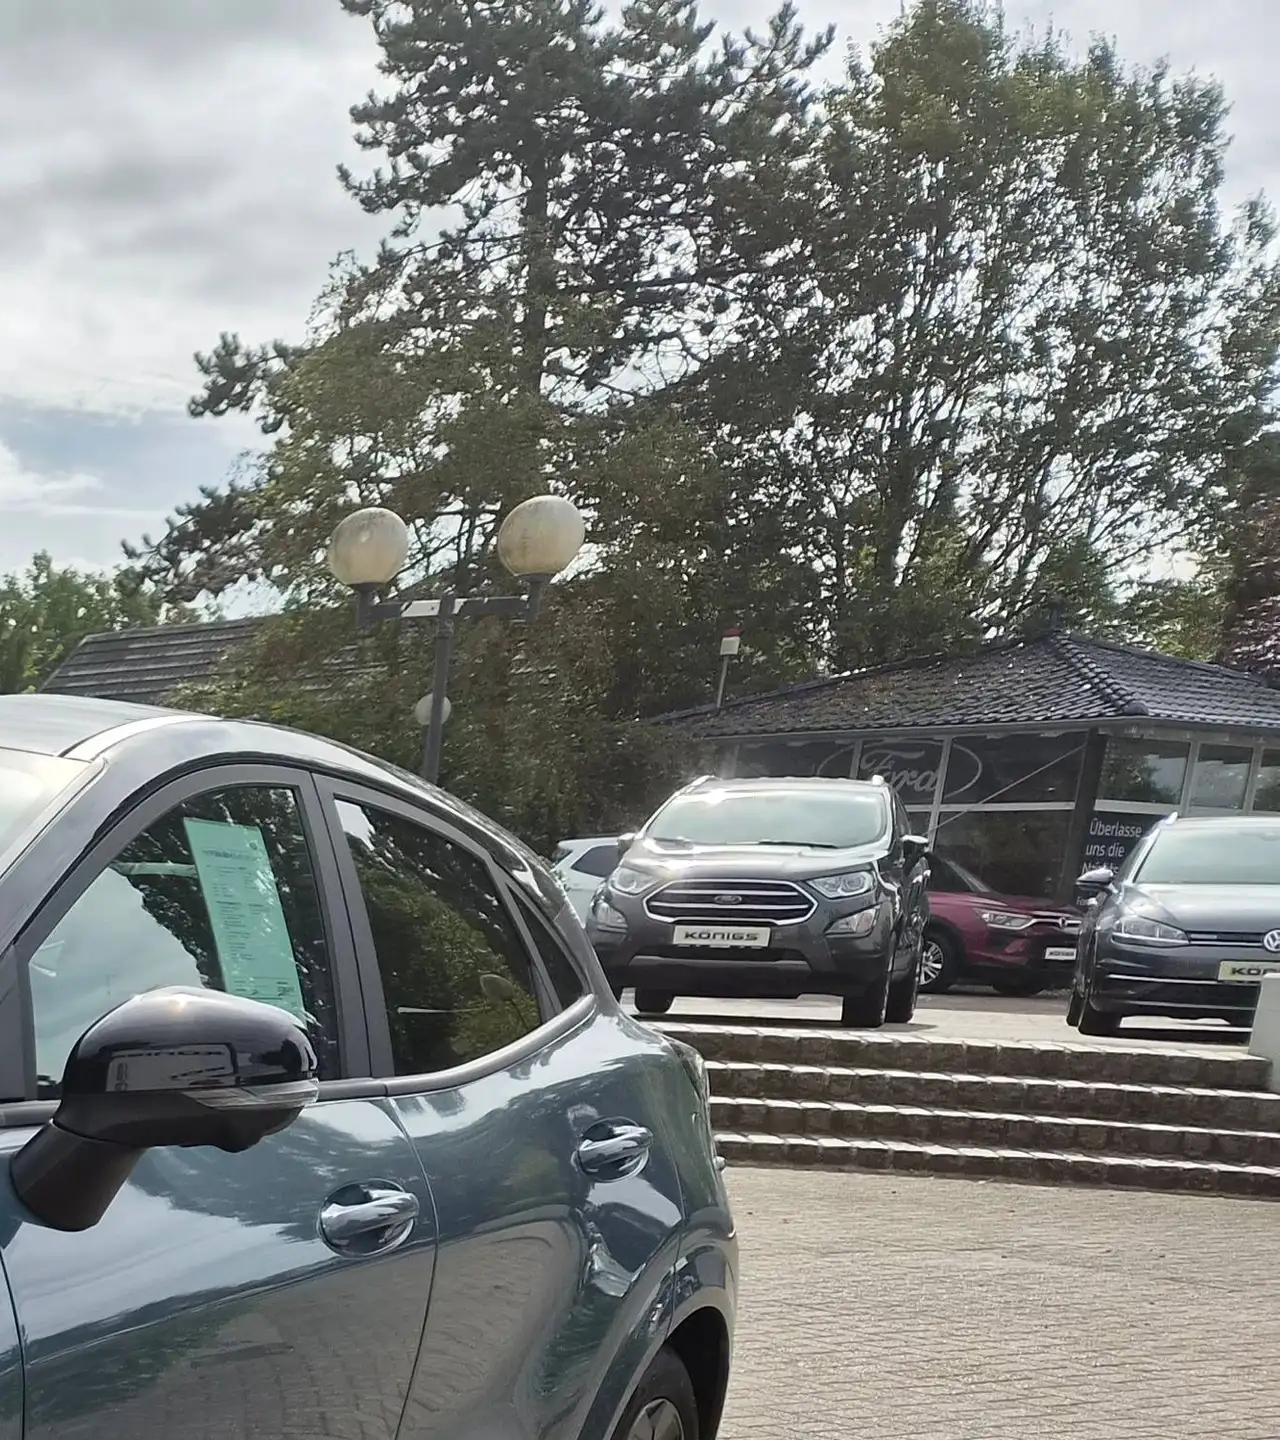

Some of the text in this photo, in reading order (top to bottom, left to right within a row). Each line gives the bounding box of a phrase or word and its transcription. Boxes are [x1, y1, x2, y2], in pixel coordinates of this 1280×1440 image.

[1089, 817, 1142, 838] Überlasse
[1085, 842, 1125, 858] uns die
[684, 929, 759, 941] KÖNIGS
